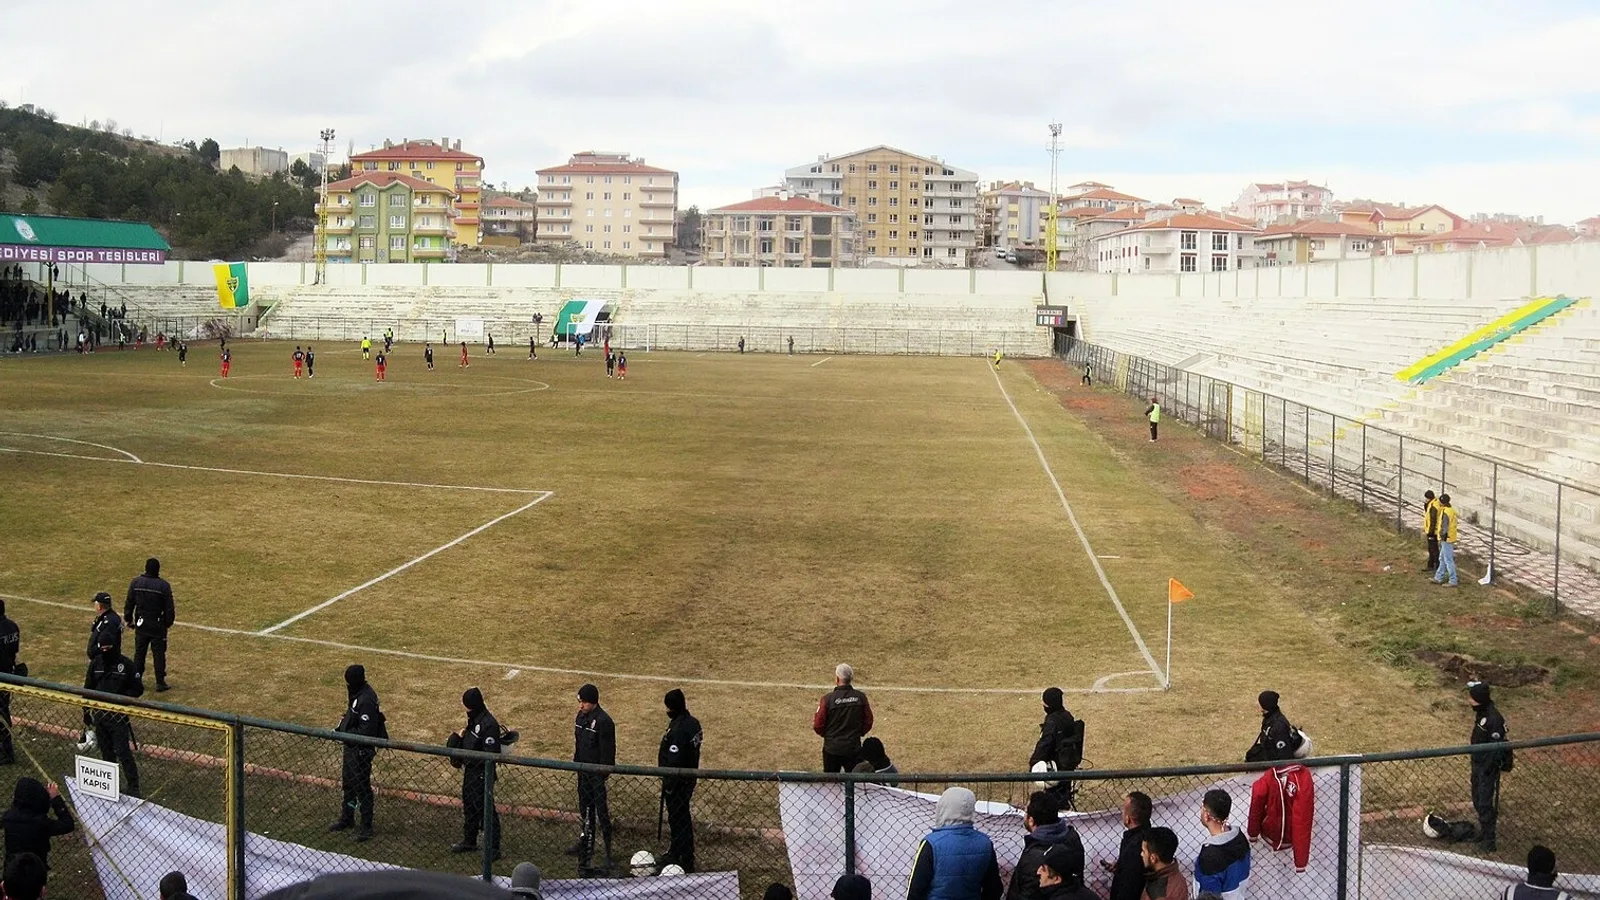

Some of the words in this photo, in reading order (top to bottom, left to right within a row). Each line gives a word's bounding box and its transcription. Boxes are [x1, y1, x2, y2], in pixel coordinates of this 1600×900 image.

[58, 250, 94, 261] SPOR
[98, 249, 160, 262] TESİSLERİ
[83, 778, 110, 790] KAPISI
